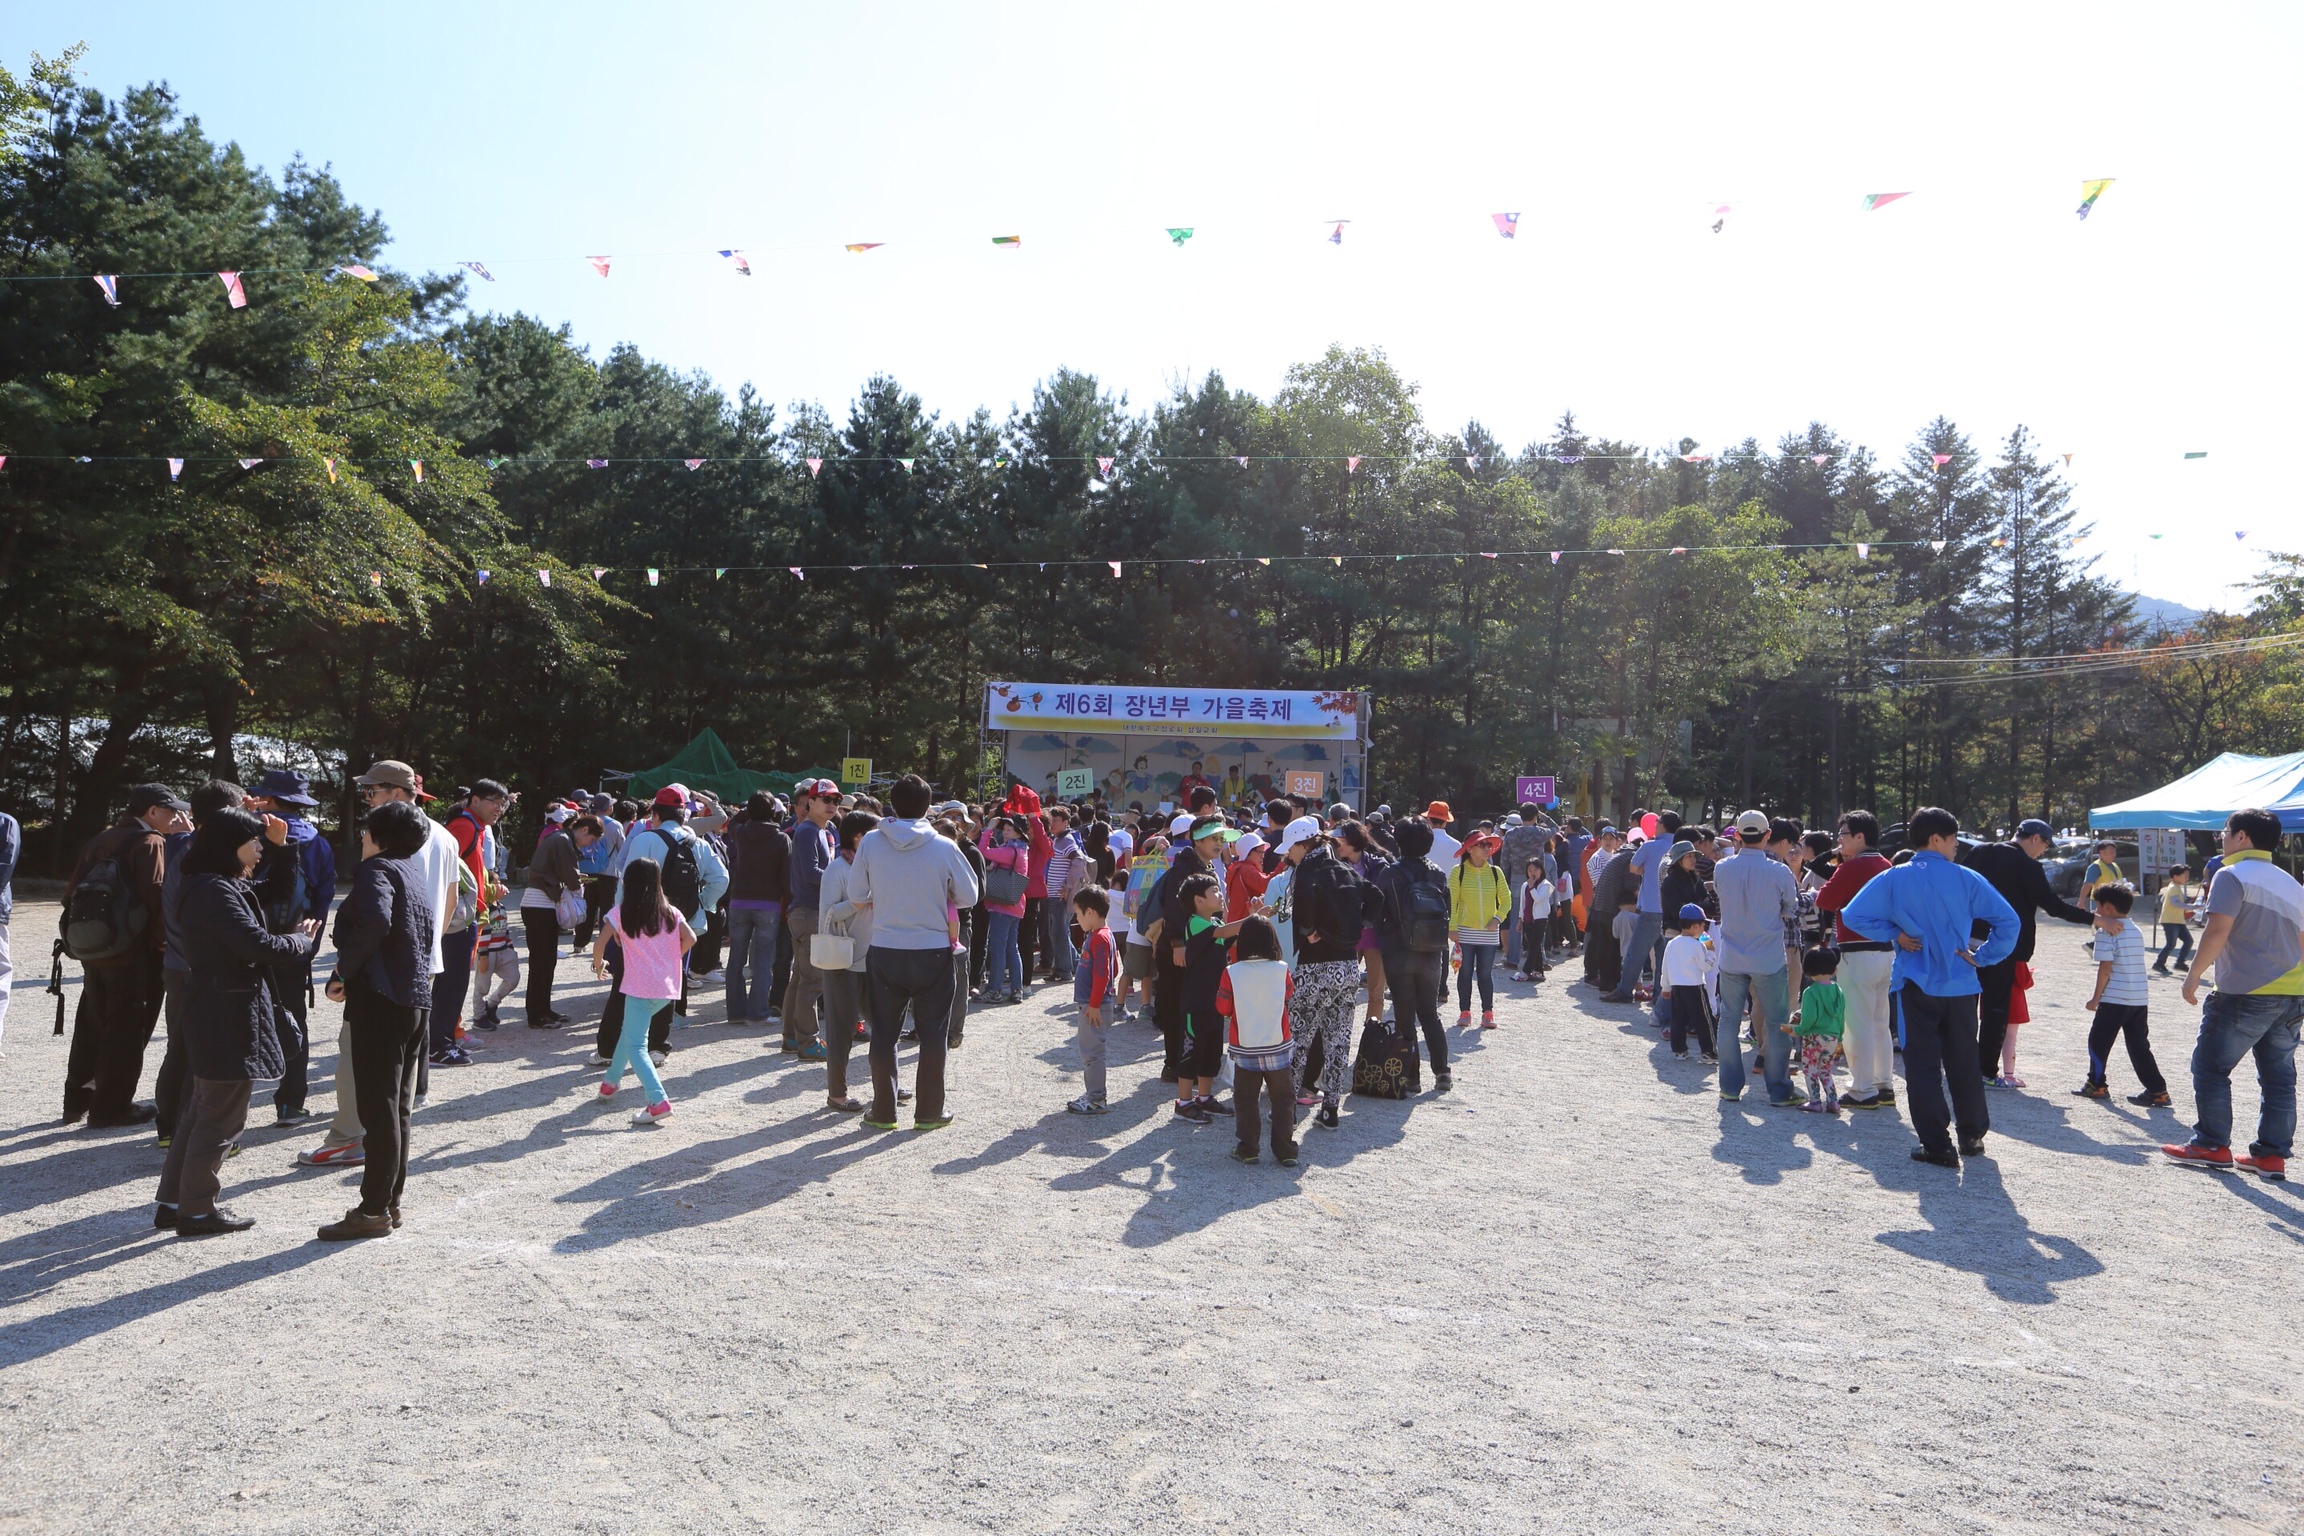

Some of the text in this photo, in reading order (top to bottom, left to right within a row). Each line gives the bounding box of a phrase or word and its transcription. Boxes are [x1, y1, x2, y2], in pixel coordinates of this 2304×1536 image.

[1055, 692, 1291, 721] 제6회 장년부 가을축제
[1122, 724, 1183, 733] 대한예수교장로회
[850, 764, 865, 778] 1진
[1065, 774, 1086, 790] 2진
[1294, 777, 1316, 793] 3진
[1524, 781, 1547, 798] 4진
